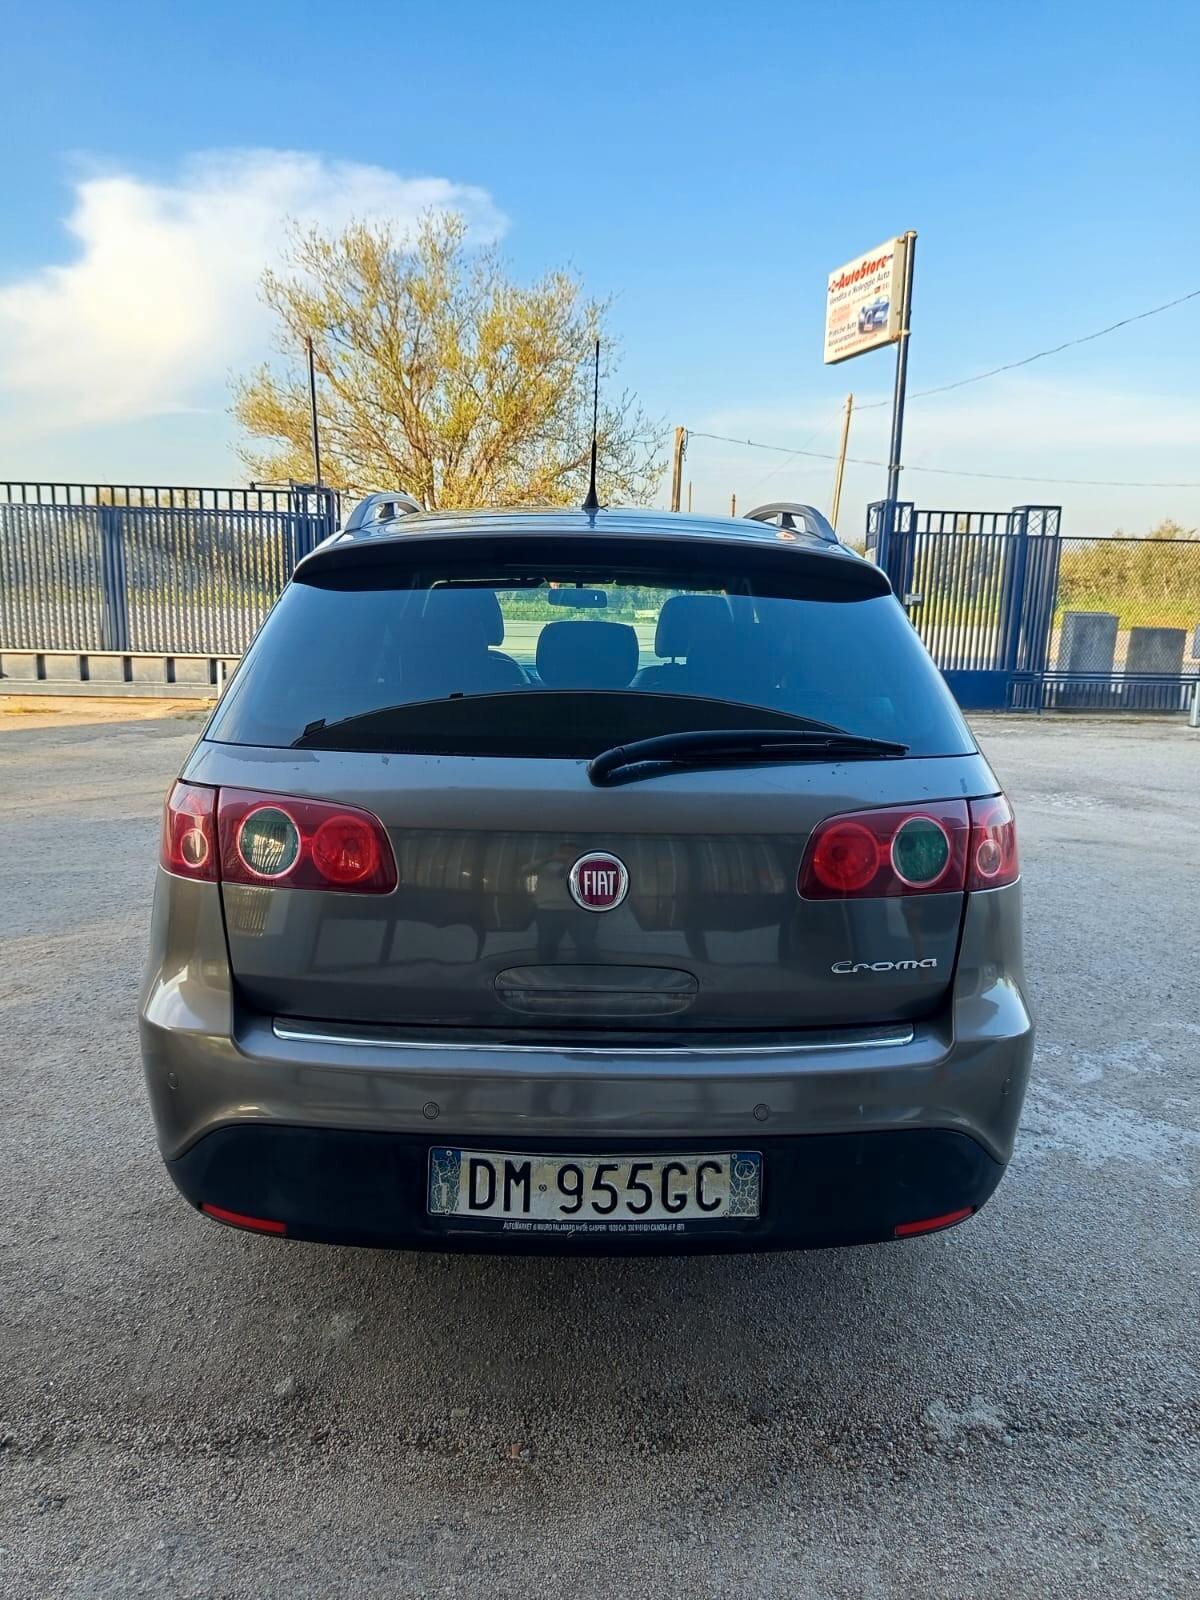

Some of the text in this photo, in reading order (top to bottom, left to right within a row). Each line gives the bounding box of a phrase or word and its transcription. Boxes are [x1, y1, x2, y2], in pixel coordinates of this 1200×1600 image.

[583, 870, 616, 896] FIAT
[831, 958, 938, 974] Croma
[468, 1157, 723, 1215] DM 955GC
